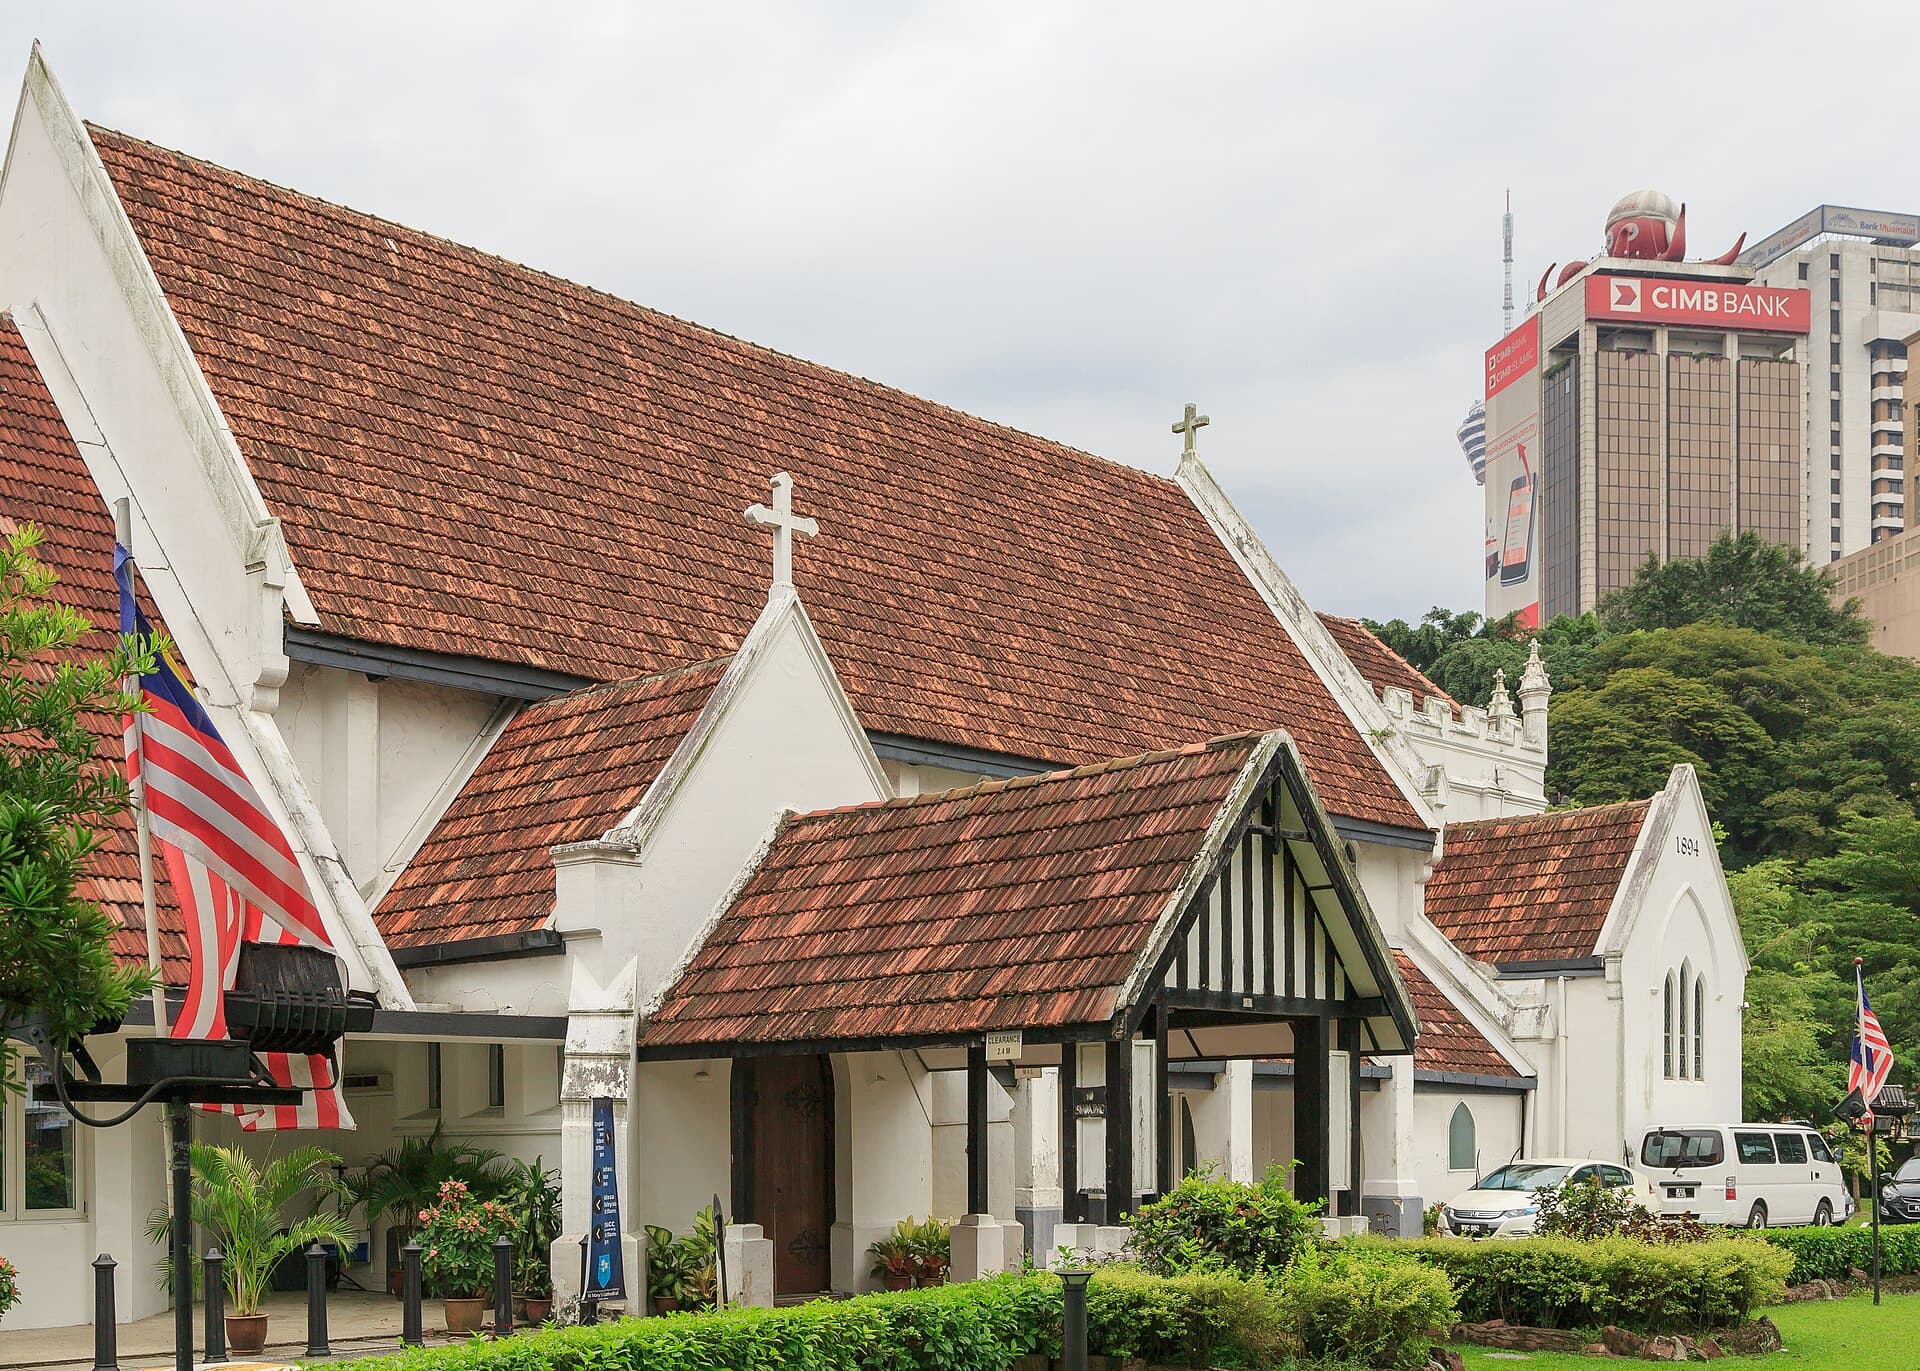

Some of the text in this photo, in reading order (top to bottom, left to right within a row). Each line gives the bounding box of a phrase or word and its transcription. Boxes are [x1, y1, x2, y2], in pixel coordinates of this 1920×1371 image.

[1860, 221, 1878, 231] Bank
[1879, 223, 1916, 235] Muamalat
[1651, 286, 1791, 318] CIMB BANK
[1676, 835, 1699, 857] 1894
[988, 1035, 1021, 1044] CLEARANCE
